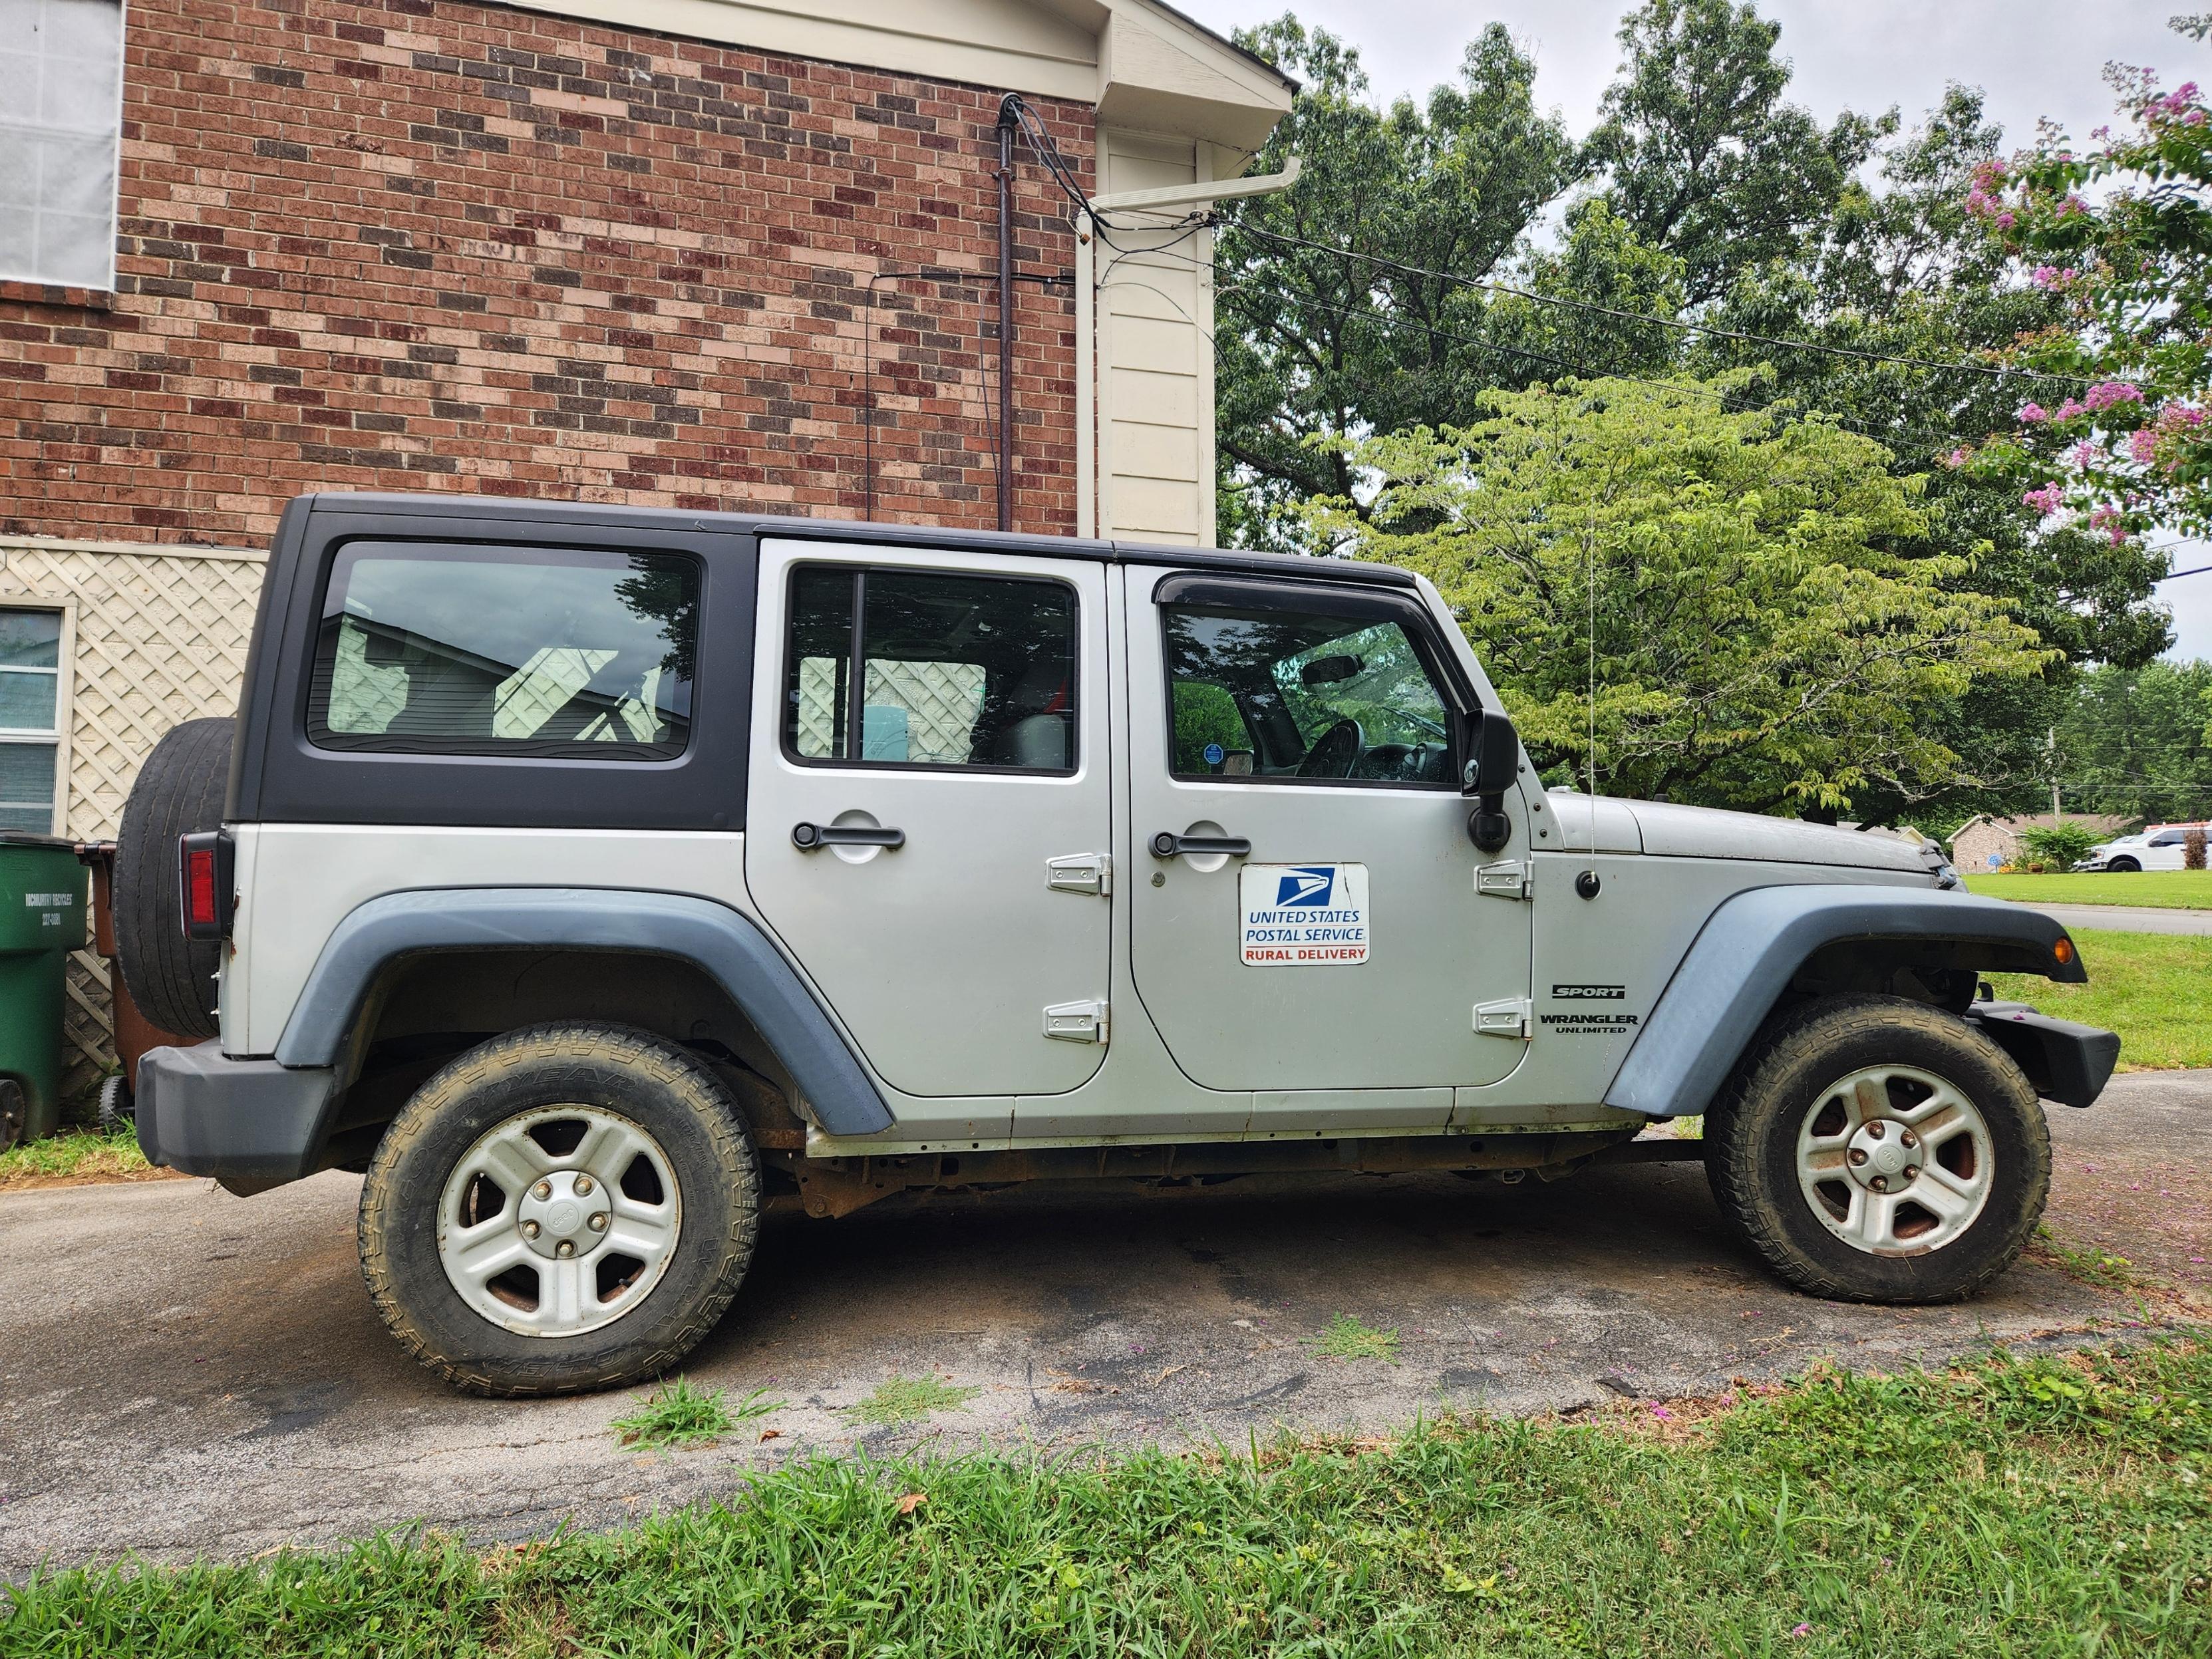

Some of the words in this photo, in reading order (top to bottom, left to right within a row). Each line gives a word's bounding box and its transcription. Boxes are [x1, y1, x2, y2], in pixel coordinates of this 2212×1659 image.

[1250, 911, 1307, 923] UNITED
[1309, 910, 1360, 923] STATES
[1246, 930, 1301, 941] POSTAL
[1305, 929, 1364, 941] SERVICE
[1246, 951, 1293, 960] RURAL
[1298, 949, 1366, 960] DELIVERY
[1554, 986, 1625, 997] SPORT
[1540, 1015, 1639, 1025] WRANGLER
[400, 1066, 638, 1212] GOODYEAR
[1883, 1149, 1898, 1167] Jeep
[553, 1208, 573, 1227] Jeep
[484, 1237, 719, 1377] WRANGLER
